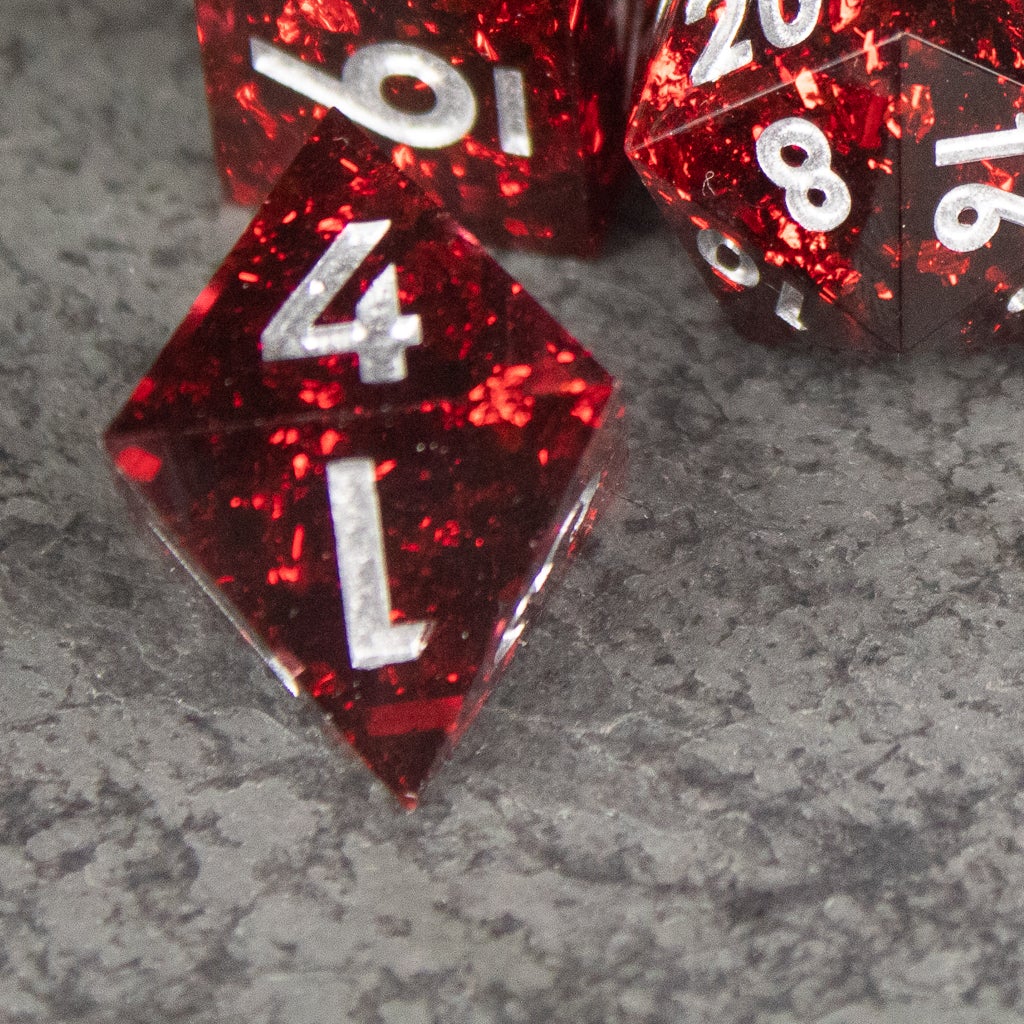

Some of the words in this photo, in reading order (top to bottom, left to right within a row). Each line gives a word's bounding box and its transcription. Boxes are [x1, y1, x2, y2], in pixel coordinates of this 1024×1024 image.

[755, 117, 852, 232] 8
[261, 218, 423, 384] 4
[326, 456, 435, 670] 1
